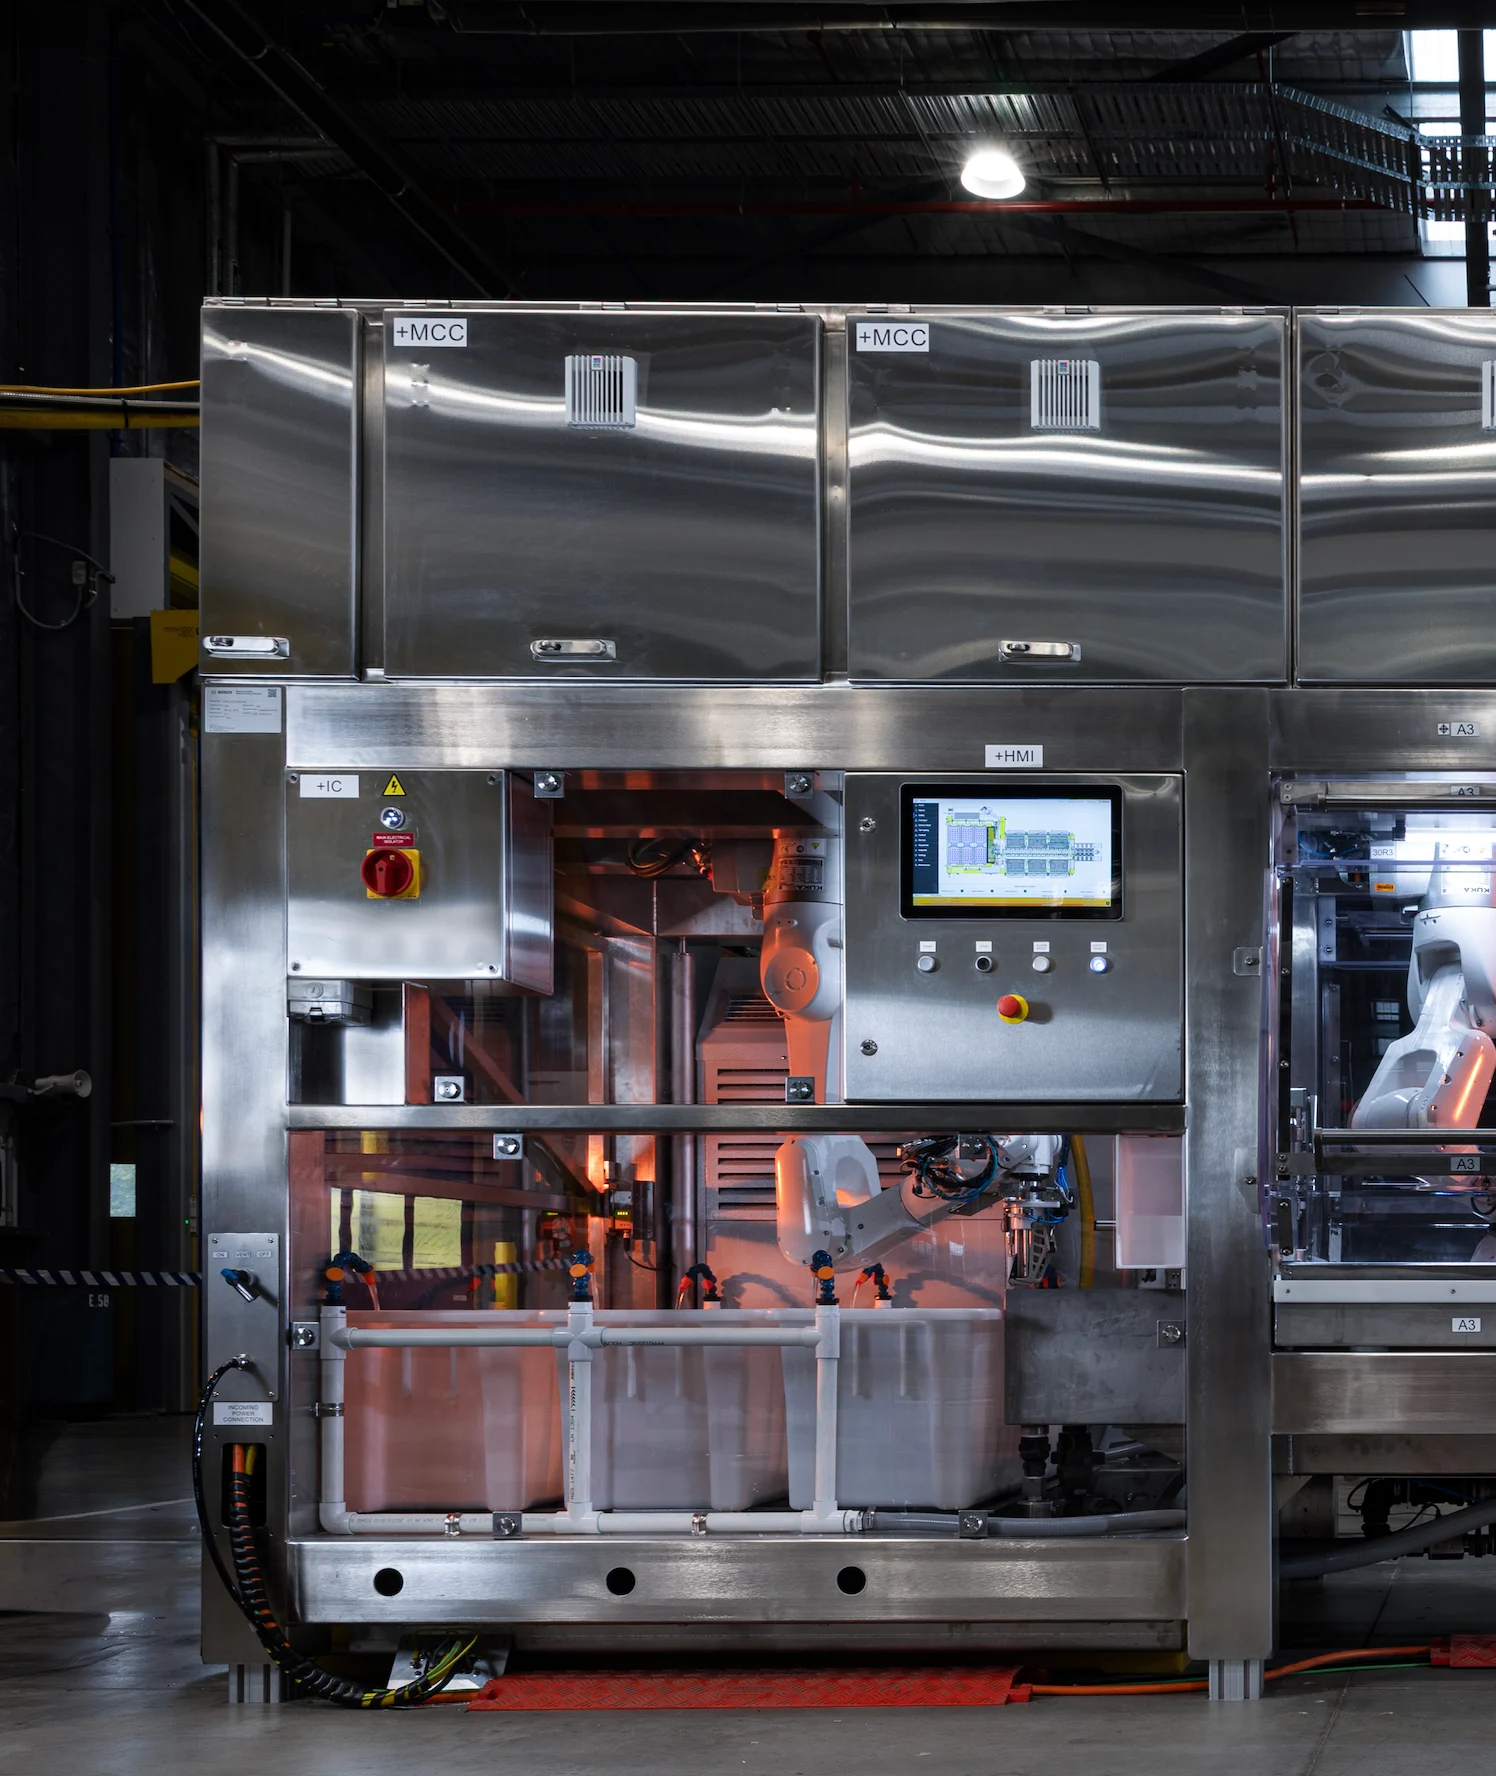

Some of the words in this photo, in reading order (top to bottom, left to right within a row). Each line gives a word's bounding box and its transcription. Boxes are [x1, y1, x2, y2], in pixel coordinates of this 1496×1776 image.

[396, 323, 465, 342] +MCC
[859, 328, 927, 347] +MCC
[1456, 723, 1475, 735] A3
[994, 750, 1034, 762] +HMI
[316, 780, 342, 792] +IC
[1457, 787, 1475, 796] A3
[1372, 848, 1394, 856] 30R3
[1456, 1158, 1475, 1170] A3
[1457, 1319, 1476, 1331] A3
